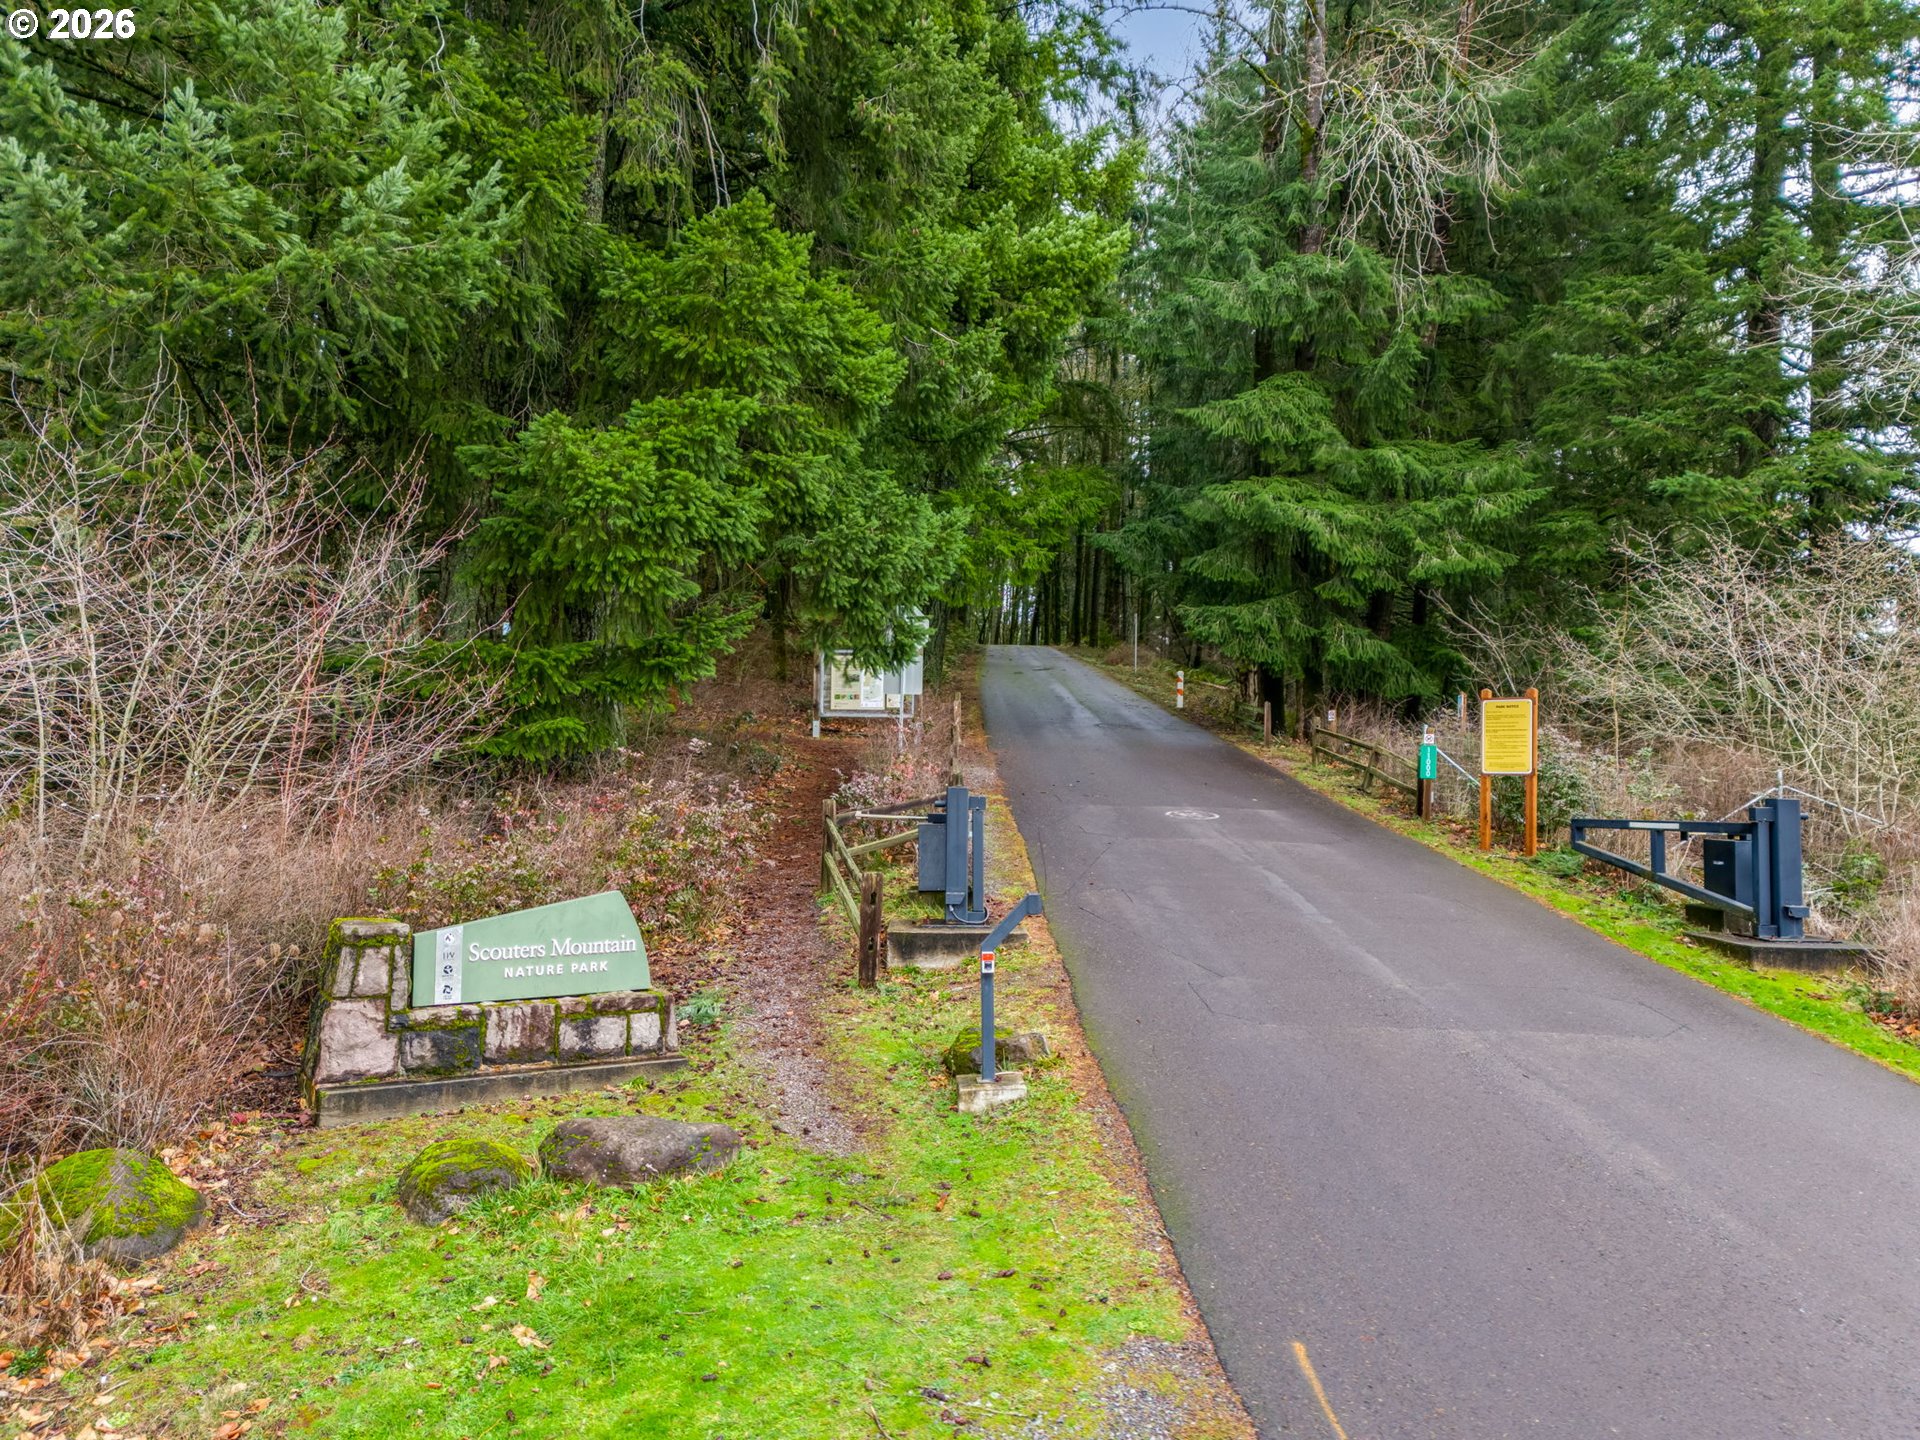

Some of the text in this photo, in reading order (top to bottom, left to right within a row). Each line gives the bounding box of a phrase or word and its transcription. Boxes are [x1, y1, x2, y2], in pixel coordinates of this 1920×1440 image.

[468, 942, 546, 962] Scouters
[550, 935, 637, 957] Mountain
[504, 960, 609, 978] NATURE PARK
